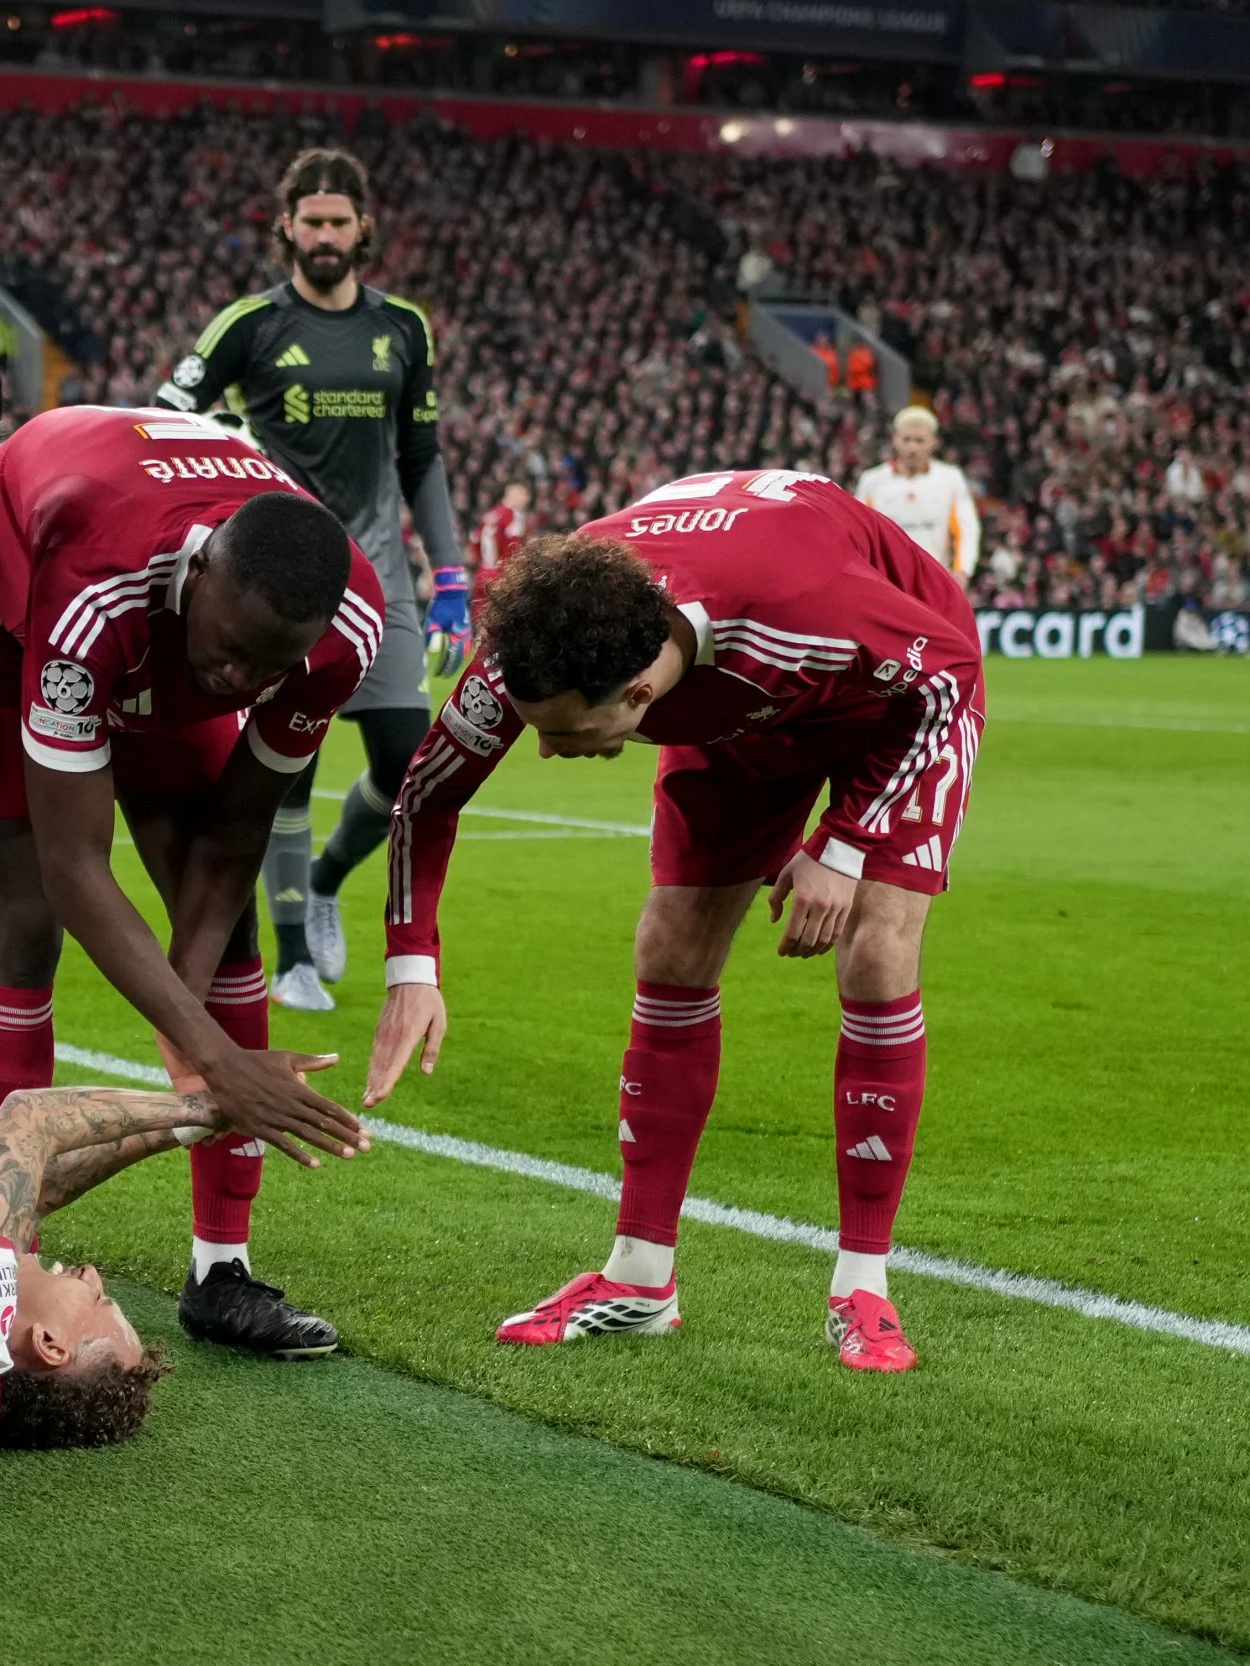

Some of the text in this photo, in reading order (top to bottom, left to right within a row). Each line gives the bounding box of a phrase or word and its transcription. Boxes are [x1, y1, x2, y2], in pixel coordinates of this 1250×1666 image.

[313, 390, 385, 405] standard
[313, 403, 386, 418] chartered
[976, 603, 1145, 658] rcard
[619, 1075, 642, 1096] FC
[846, 1091, 896, 1112] LFC
